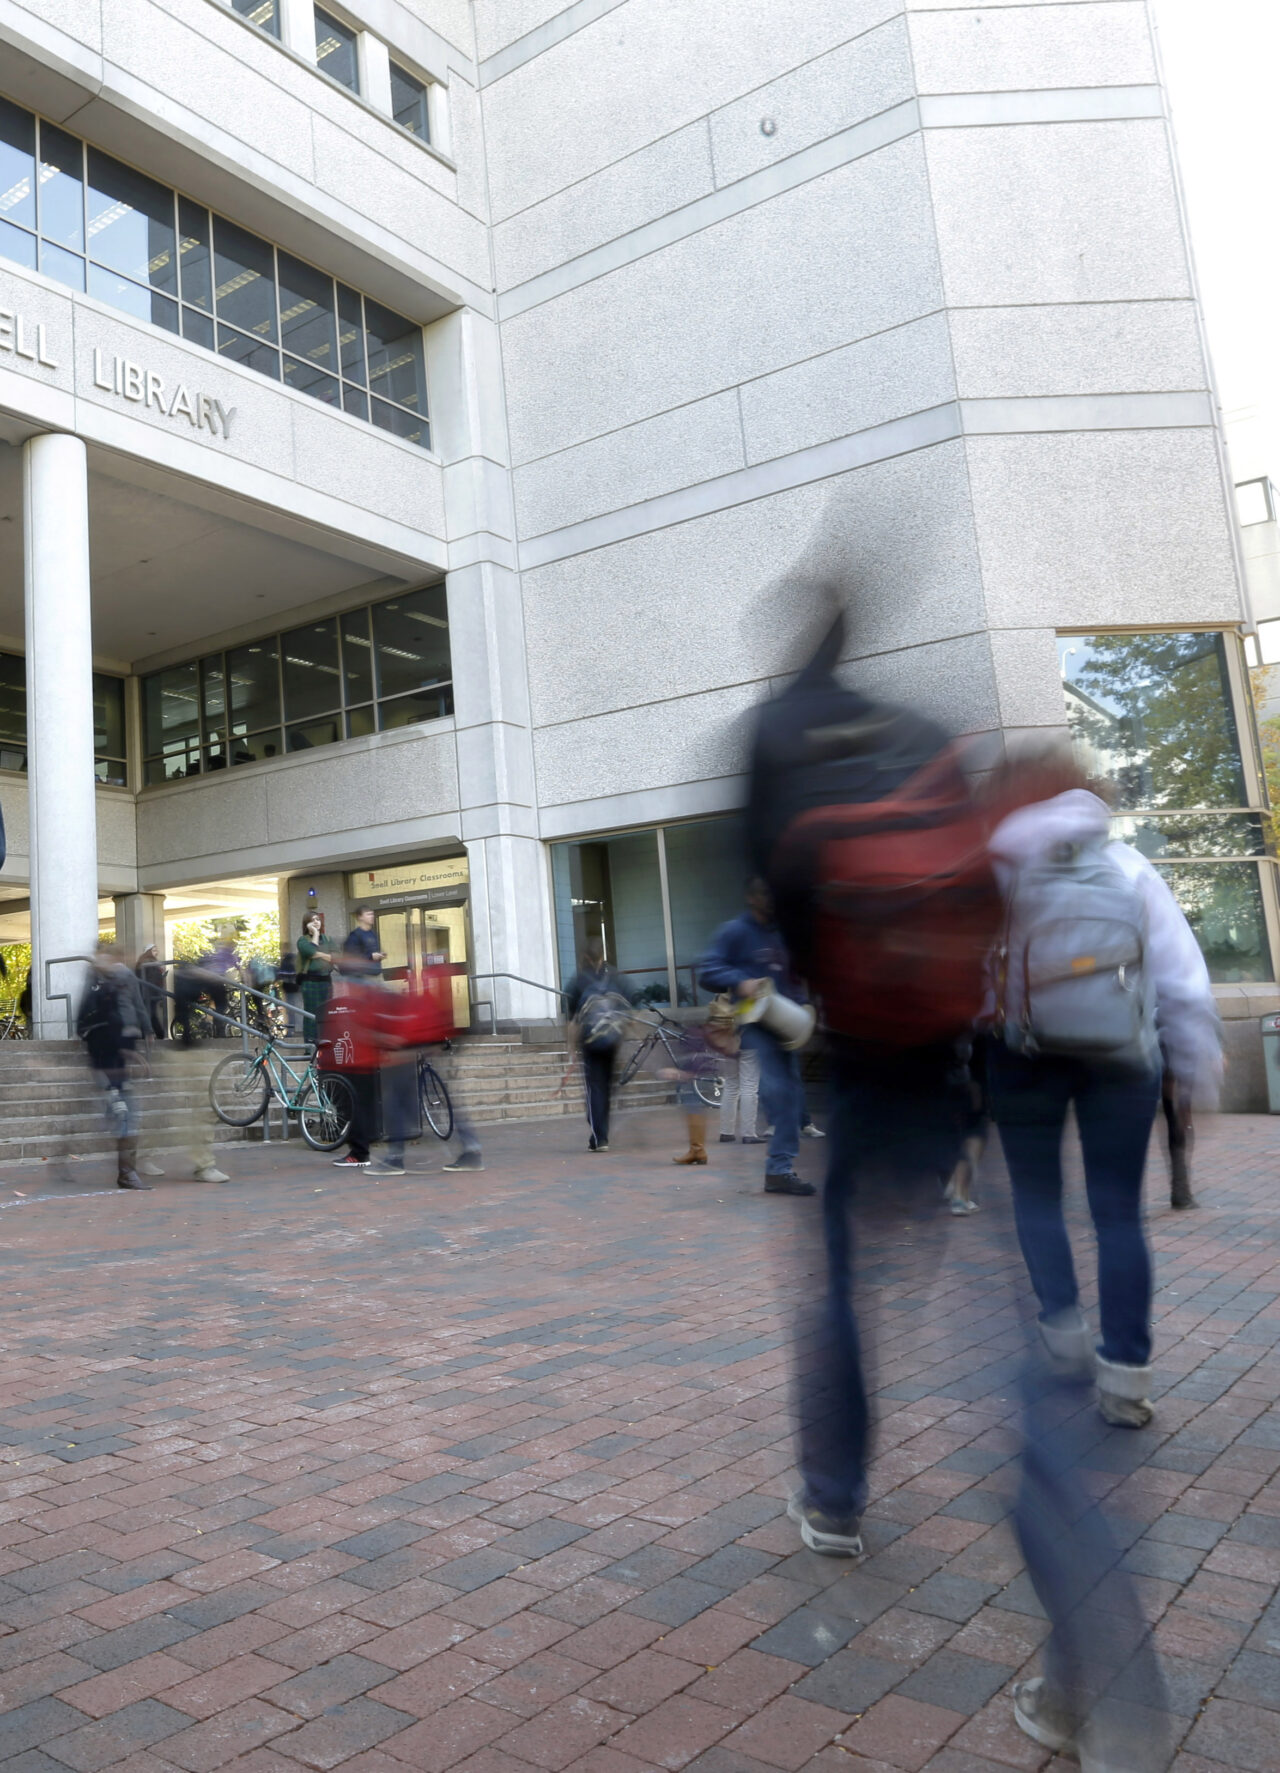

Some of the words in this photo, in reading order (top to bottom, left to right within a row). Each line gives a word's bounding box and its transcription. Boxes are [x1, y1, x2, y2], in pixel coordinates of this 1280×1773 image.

[93, 347, 238, 440] LIBRARY
[371, 880, 388, 889] Snell
[391, 877, 417, 886] Library
[420, 871, 464, 882] Classrooms
